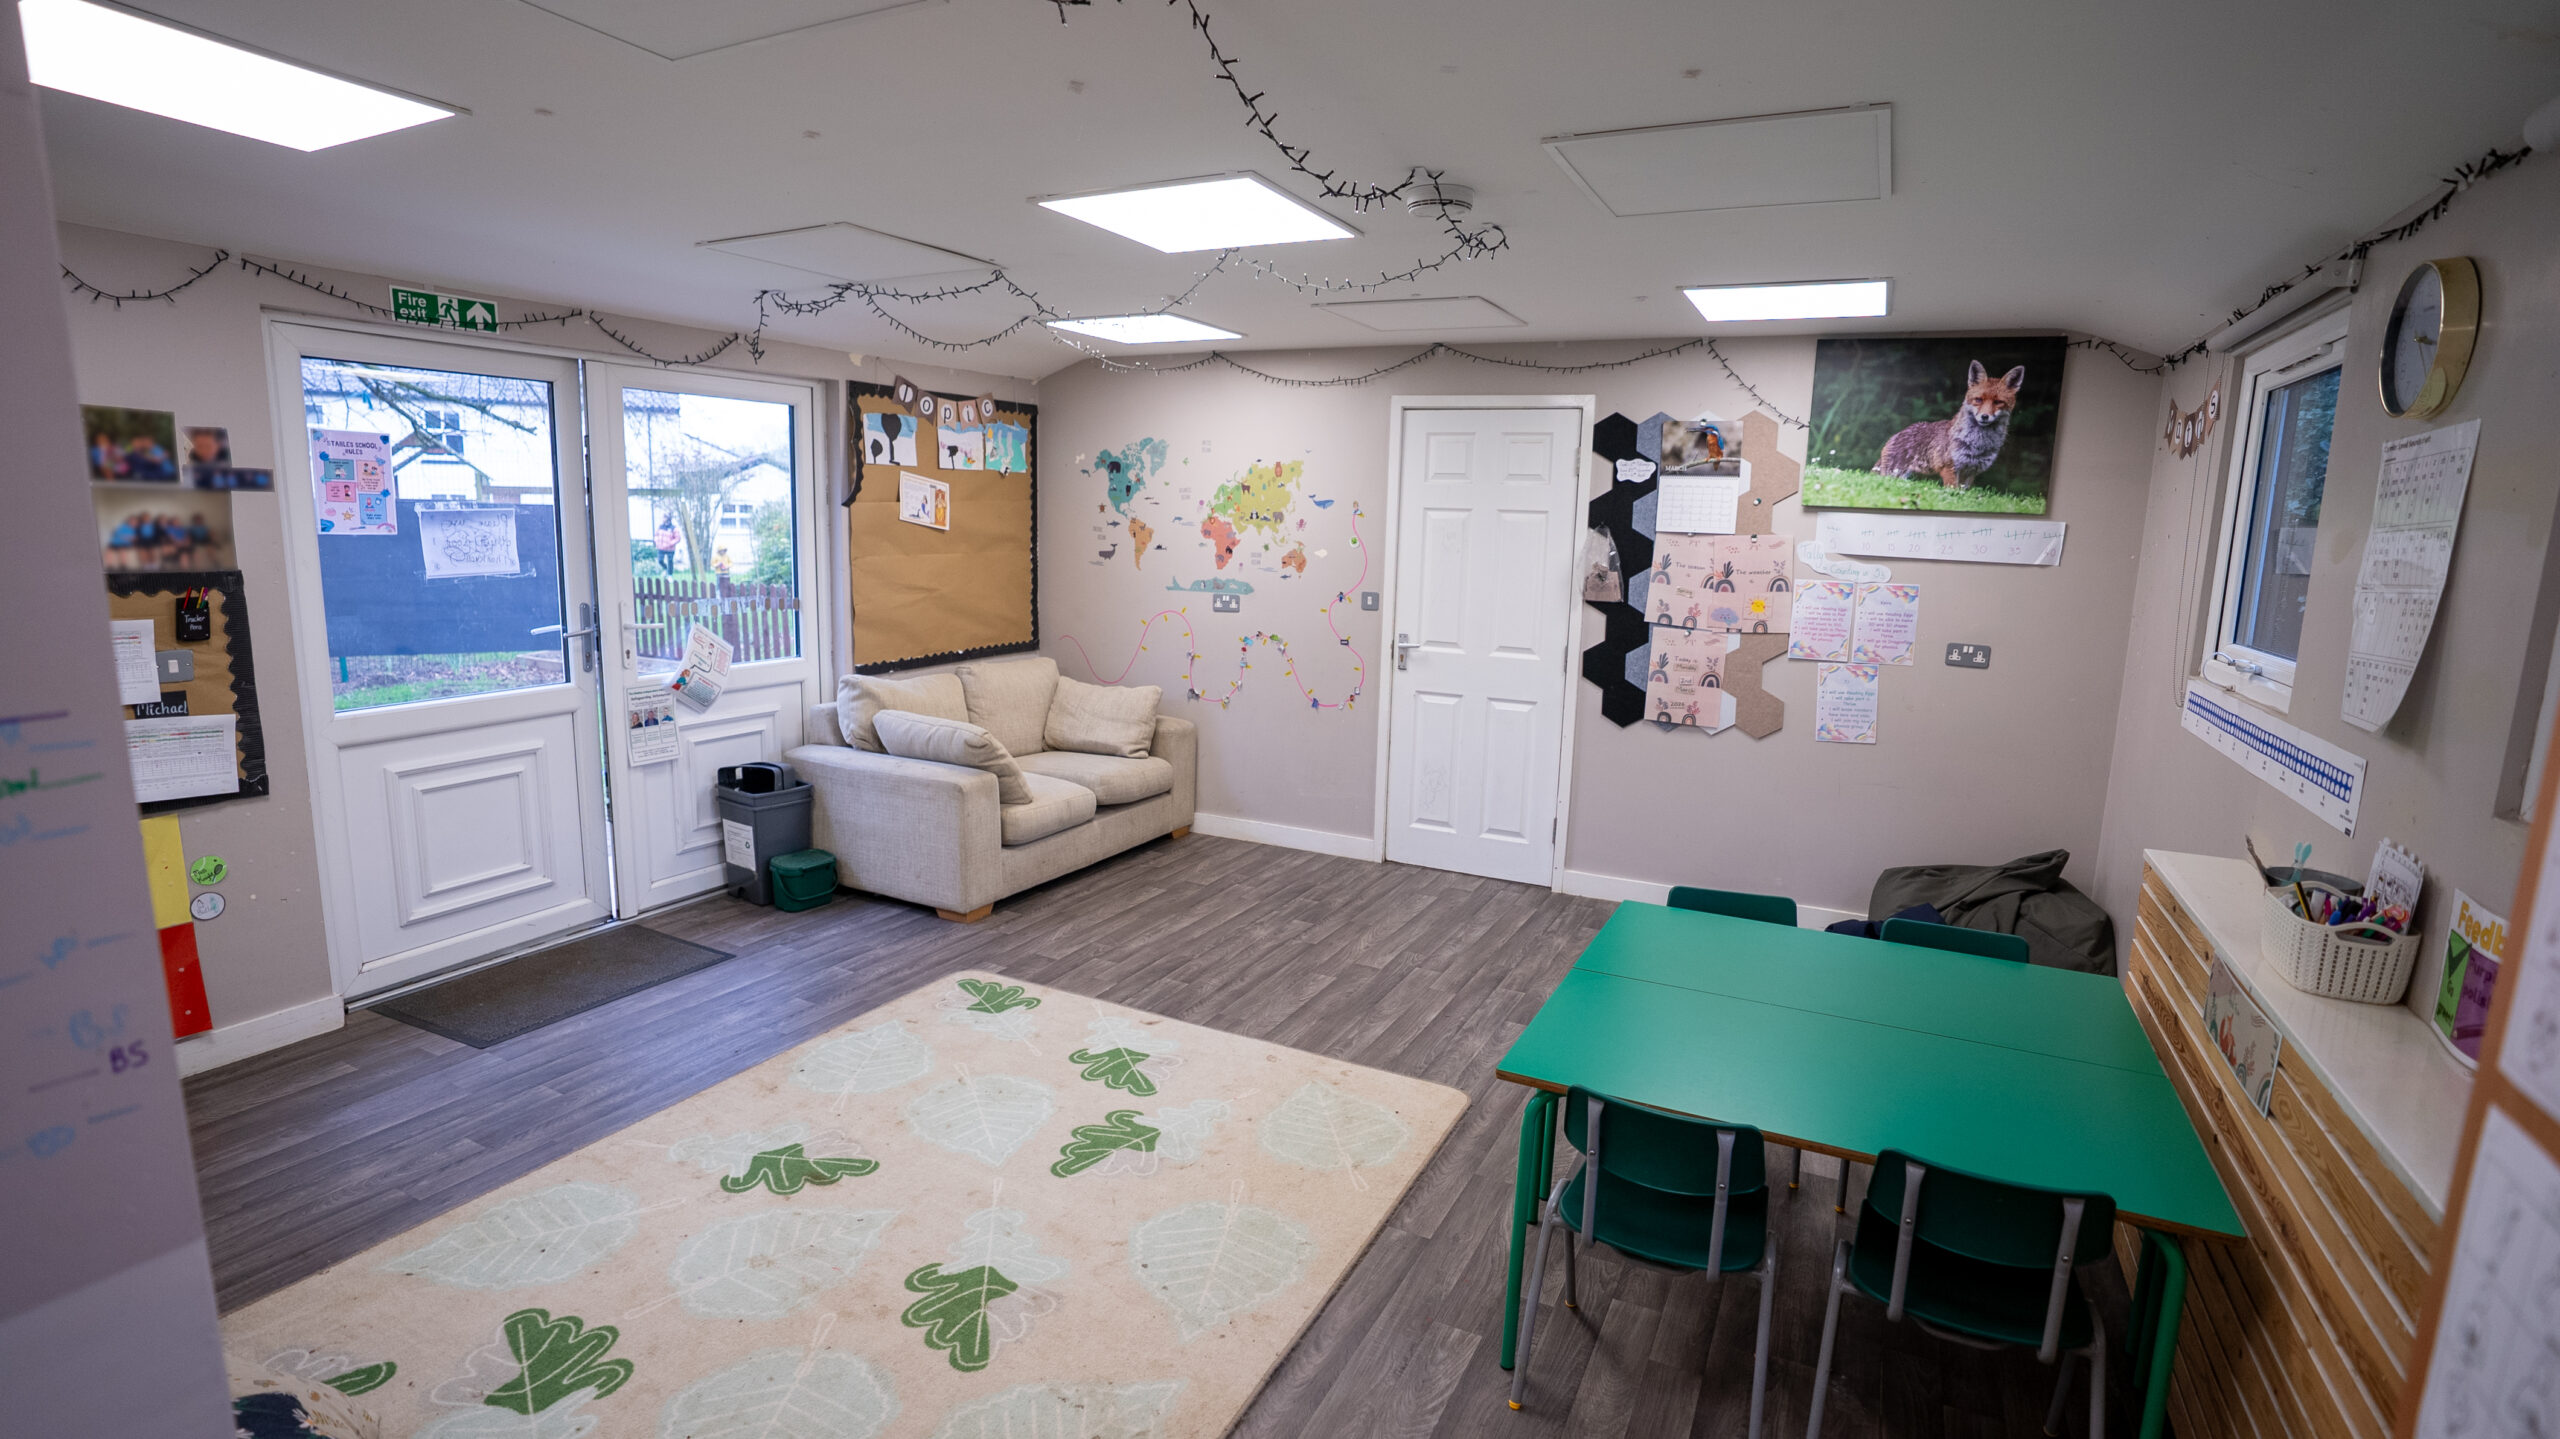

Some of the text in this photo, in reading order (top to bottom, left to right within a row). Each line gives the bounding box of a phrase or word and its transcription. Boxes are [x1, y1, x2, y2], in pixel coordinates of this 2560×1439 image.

[398, 292, 427, 307] Fire
[400, 308, 427, 318] exit
[136, 700, 188, 716] Michael
[2458, 900, 2506, 957] Feedb
[109, 1040, 149, 1074] BS
